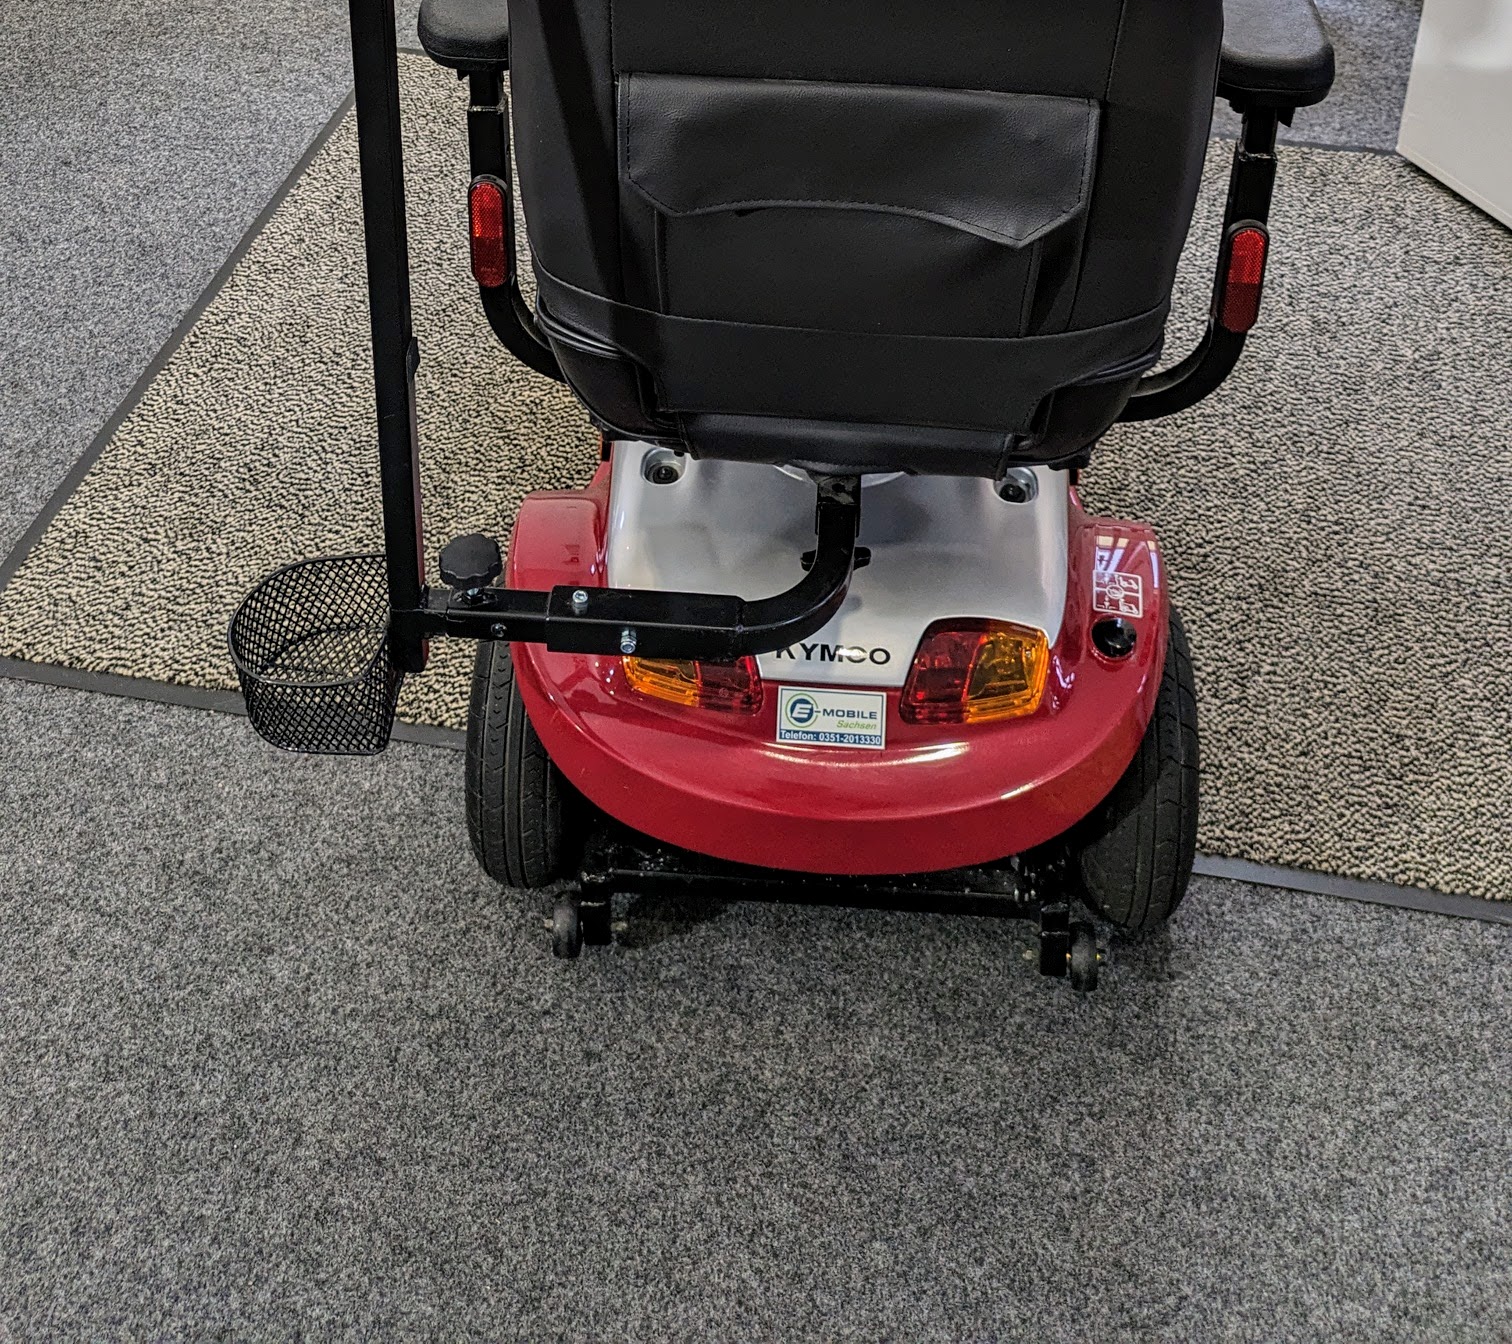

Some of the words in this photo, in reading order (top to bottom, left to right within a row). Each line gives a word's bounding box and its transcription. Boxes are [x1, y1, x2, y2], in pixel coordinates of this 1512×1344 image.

[790, 702, 878, 720] E-MOBILE
[836, 719, 877, 730] Sachsen
[780, 729, 818, 741] Telefon:
[818, 731, 881, 745] 0351-2013330
